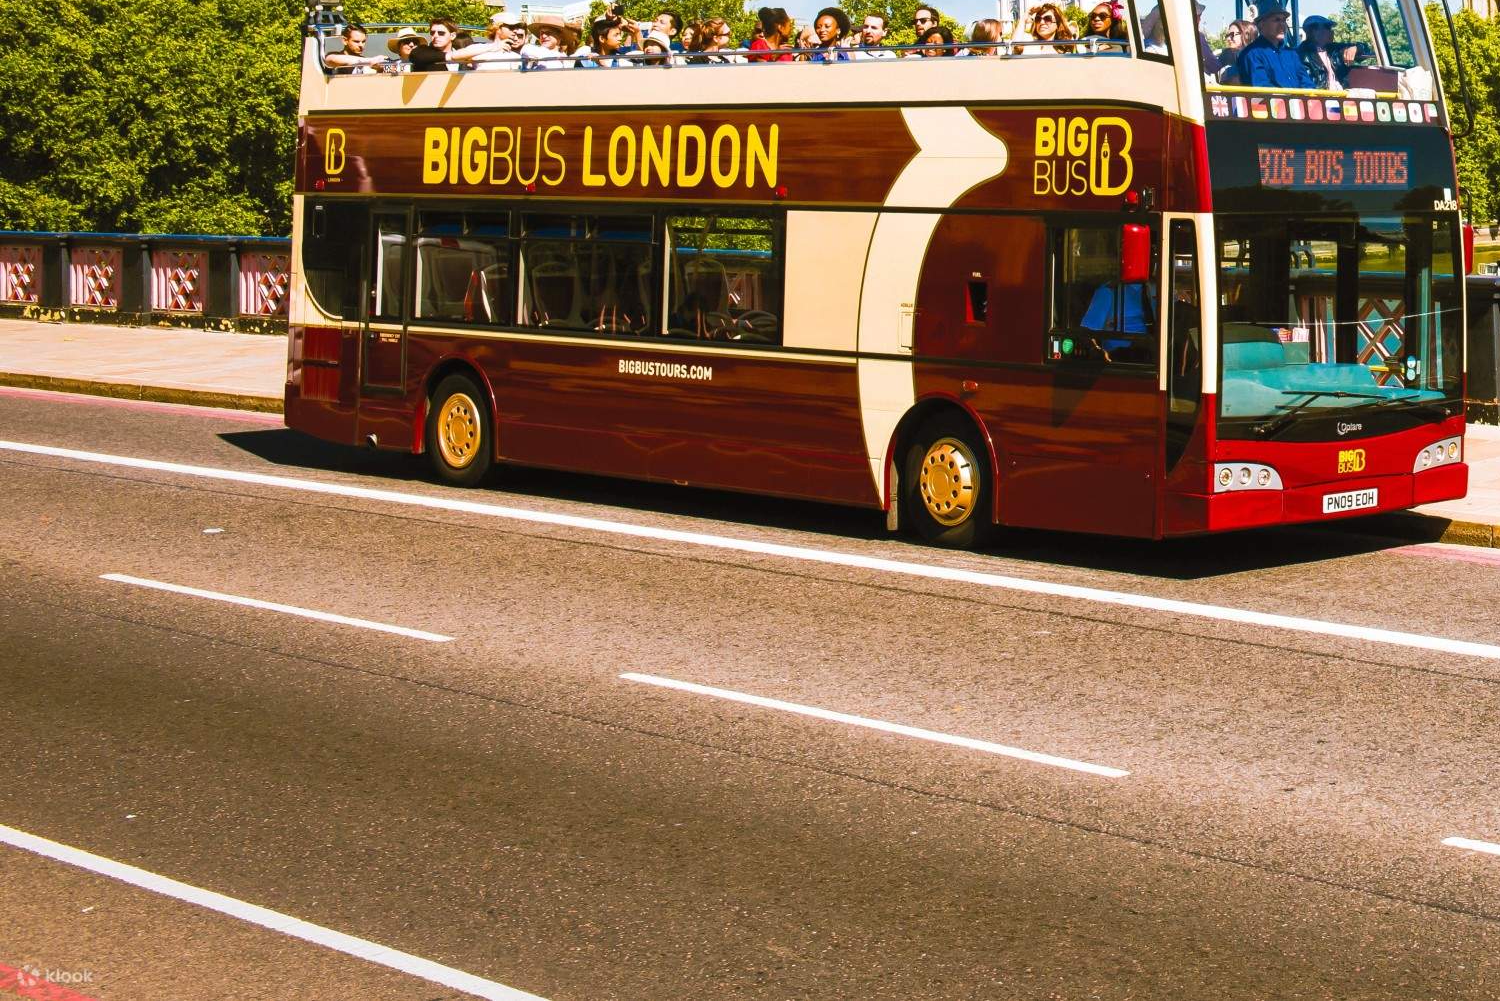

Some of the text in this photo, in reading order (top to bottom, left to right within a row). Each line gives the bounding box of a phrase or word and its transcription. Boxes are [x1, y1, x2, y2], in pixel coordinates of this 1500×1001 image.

[1035, 117, 1088, 156] BIG
[582, 123, 779, 188] LONDON
[1258, 148, 1408, 184] BIG BUS TOURS
[1034, 160, 1087, 195] BUS
[1433, 200, 1457, 210] DA218
[618, 359, 713, 380] BIGBUSTOURS.COM
[1339, 450, 1354, 462] BIG
[1338, 461, 1354, 473] BUS
[1327, 491, 1374, 510] PN09 EOH
